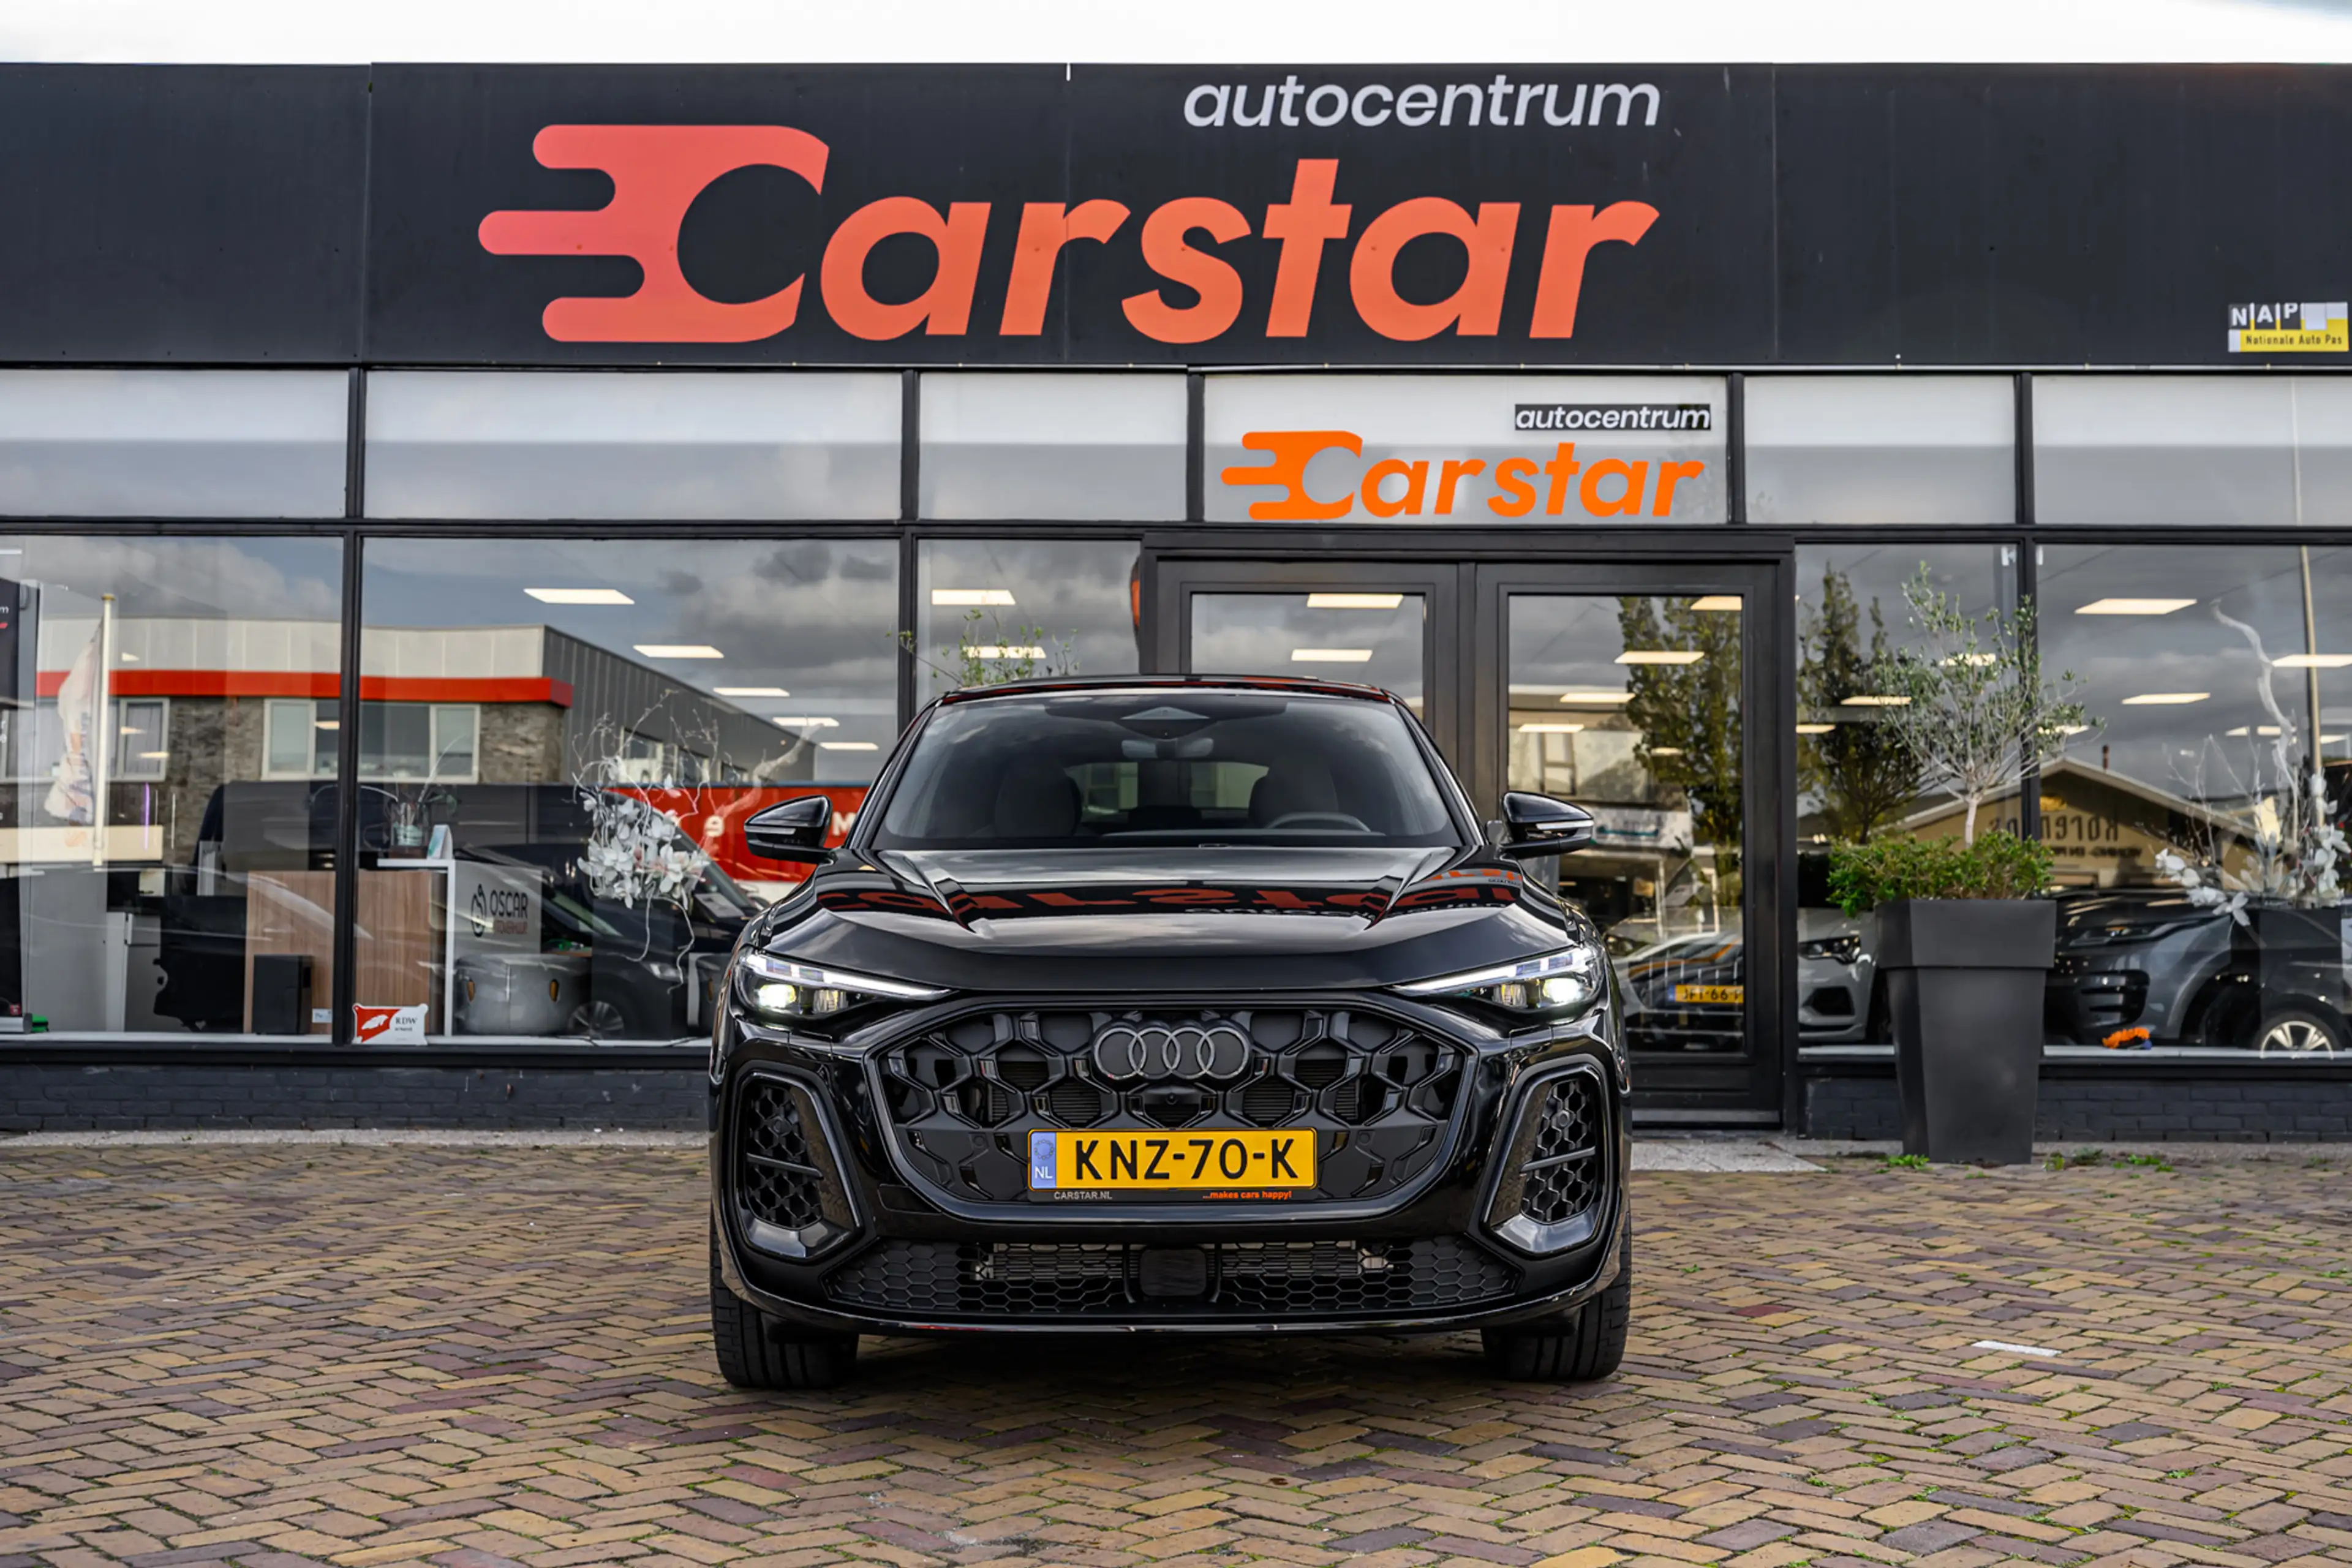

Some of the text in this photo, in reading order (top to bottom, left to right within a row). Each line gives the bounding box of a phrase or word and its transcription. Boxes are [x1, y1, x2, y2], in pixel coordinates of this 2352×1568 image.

[1183, 74, 1660, 128] autocentrum
[478, 124, 1660, 344] Carstar
[2246, 334, 2342, 345] Nationale Auto Pas
[1515, 406, 1711, 429] autocentrum
[1220, 430, 1705, 521] Carstar
[489, 889, 529, 919] OSCAR
[395, 1017, 418, 1025] RDW
[1076, 1138, 1298, 1180] KNZ-70-K
[1035, 1166, 1053, 1179] NL
[1054, 1191, 1113, 1200] CARSTAR.NL
[1262, 1190, 1292, 1200] happy!
